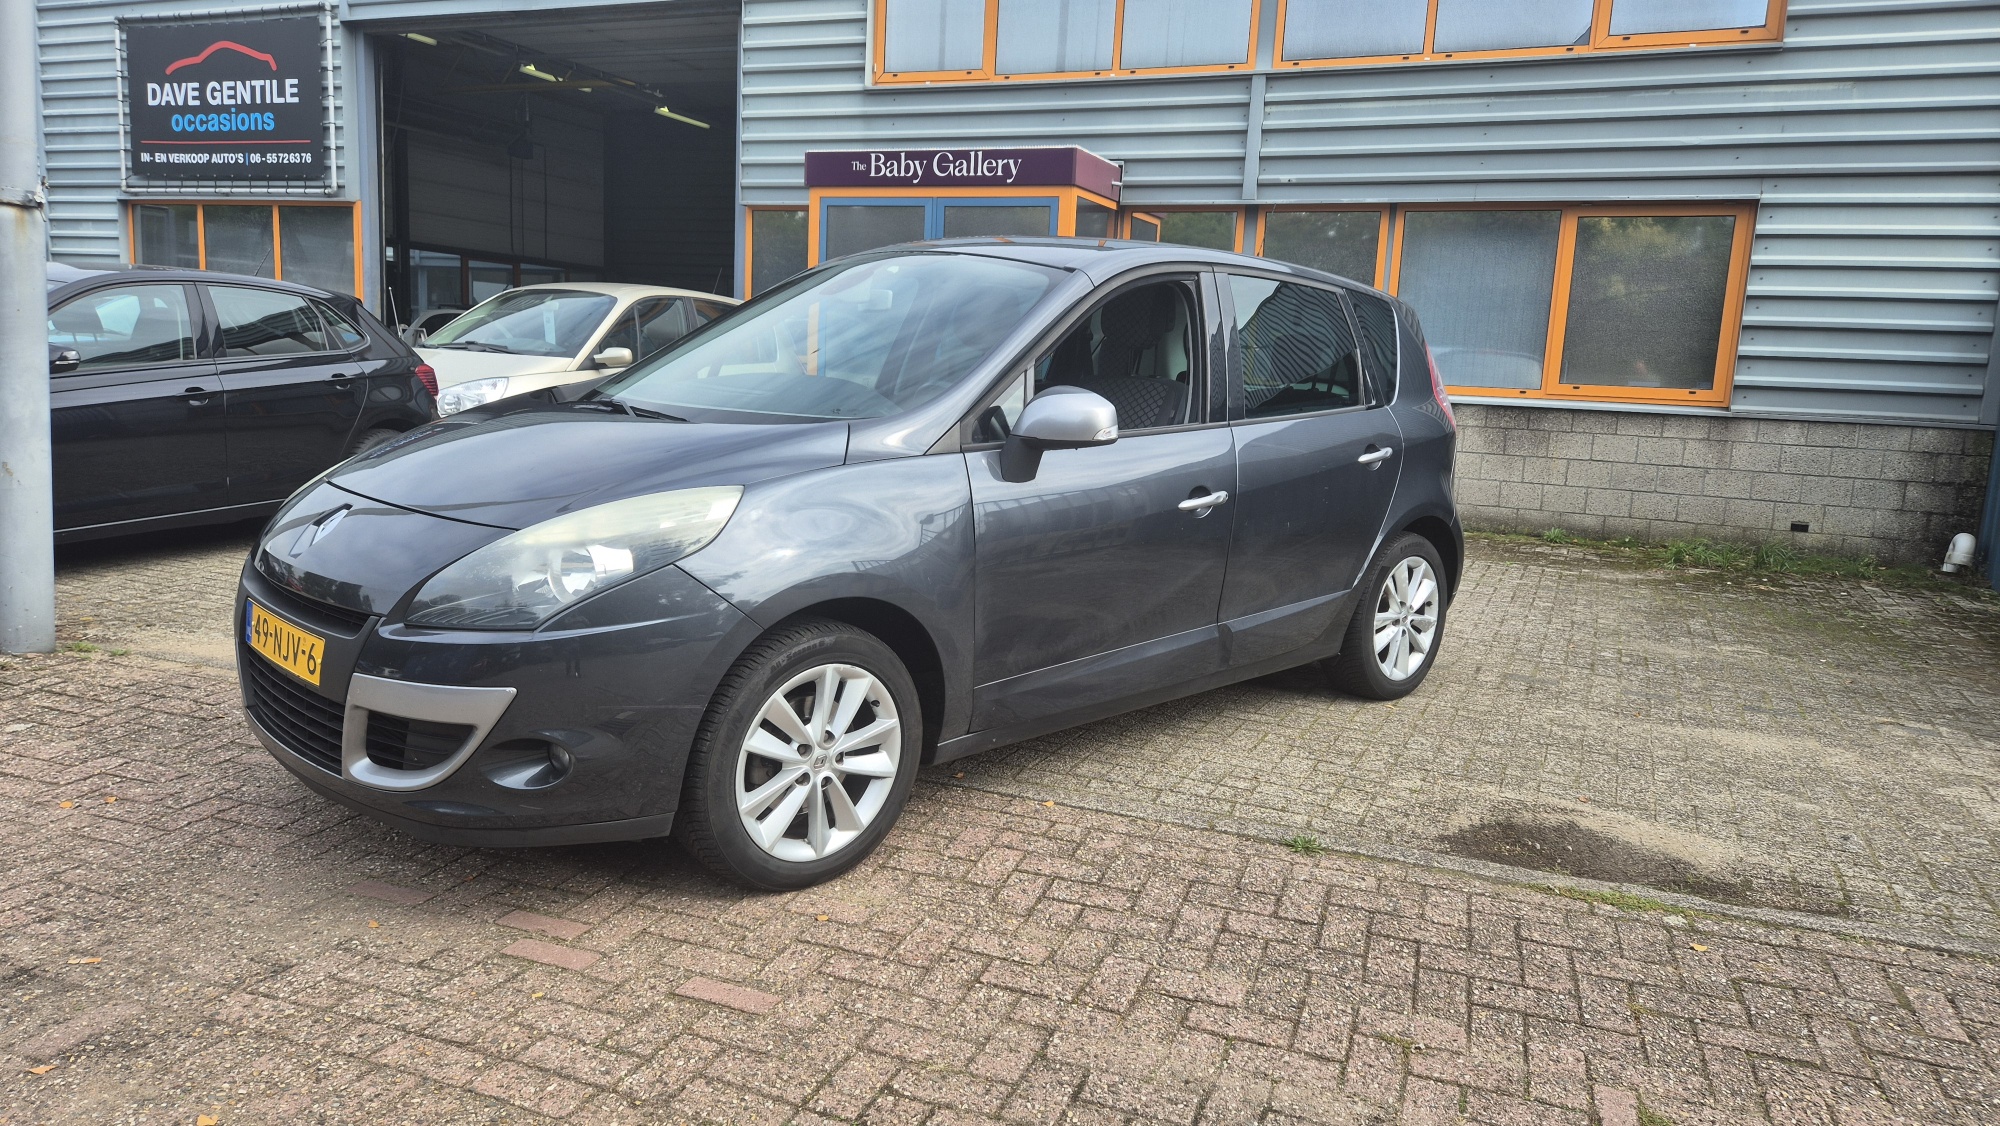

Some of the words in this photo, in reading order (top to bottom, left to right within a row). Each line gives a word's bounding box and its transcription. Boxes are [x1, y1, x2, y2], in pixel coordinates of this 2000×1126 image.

[147, 82, 201, 106] DAVE
[206, 78, 300, 106] GENTILE
[171, 107, 275, 132] occasions
[140, 152, 154, 163] IN-
[155, 153, 167, 163] EN
[168, 153, 210, 164] VERKOOP
[211, 152, 244, 164] AUTO'S
[250, 152, 312, 164] 06-55726376
[851, 160, 867, 172] The
[869, 152, 927, 184] Baby
[932, 151, 1022, 184] Gallery
[254, 613, 317, 676] 49-NJV-6
